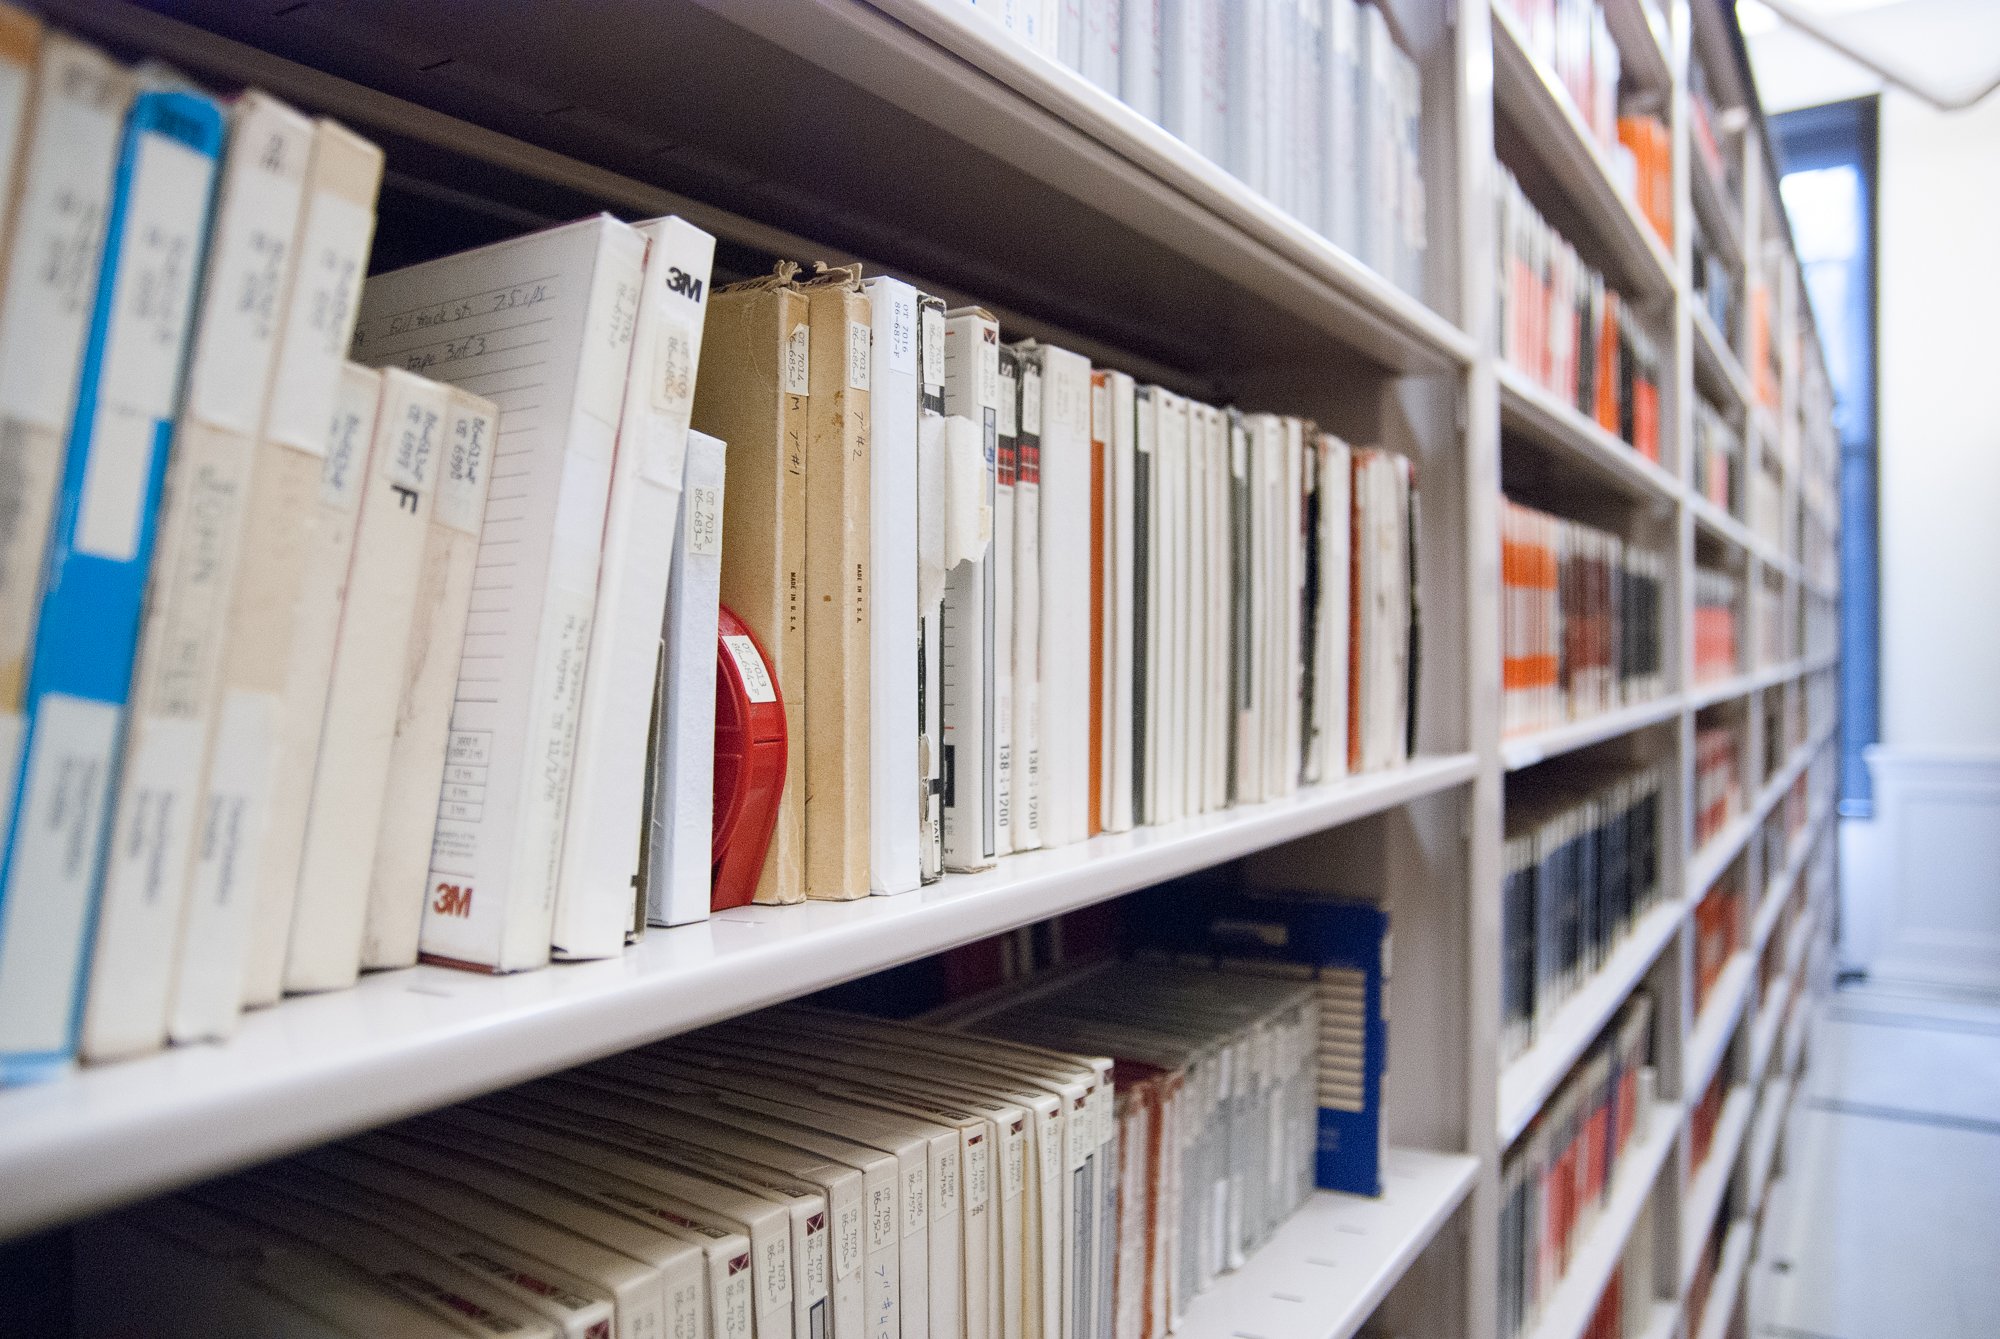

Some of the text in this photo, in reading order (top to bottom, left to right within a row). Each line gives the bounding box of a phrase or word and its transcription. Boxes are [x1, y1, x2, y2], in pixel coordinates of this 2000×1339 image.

[666, 266, 703, 303] 3M
[893, 301, 901, 358] 86-687-F
[902, 303, 909, 319] OT
[789, 333, 797, 387] 6-685-F
[797, 331, 806, 381] OT 7014
[859, 329, 867, 380] OT 7015
[391, 483, 419, 515] F
[693, 488, 703, 551] 86-683-F
[704, 490, 714, 544] OT 7012
[791, 594, 796, 602] IN
[857, 585, 862, 593] IN
[553, 649, 572, 701] Wayne,
[731, 642, 760, 696] 86-684-F
[742, 642, 767, 688] OT 7013
[433, 882, 474, 919] 3M
[851, 1208, 858, 1224] OT
[873, 1190, 882, 1246] 86-752-F
[883, 1187, 891, 1236] OT 7081
[777, 1239, 786, 1291] OT 7073
[816, 1233, 823, 1248] OT
[842, 1212, 850, 1270] 86-750-F
